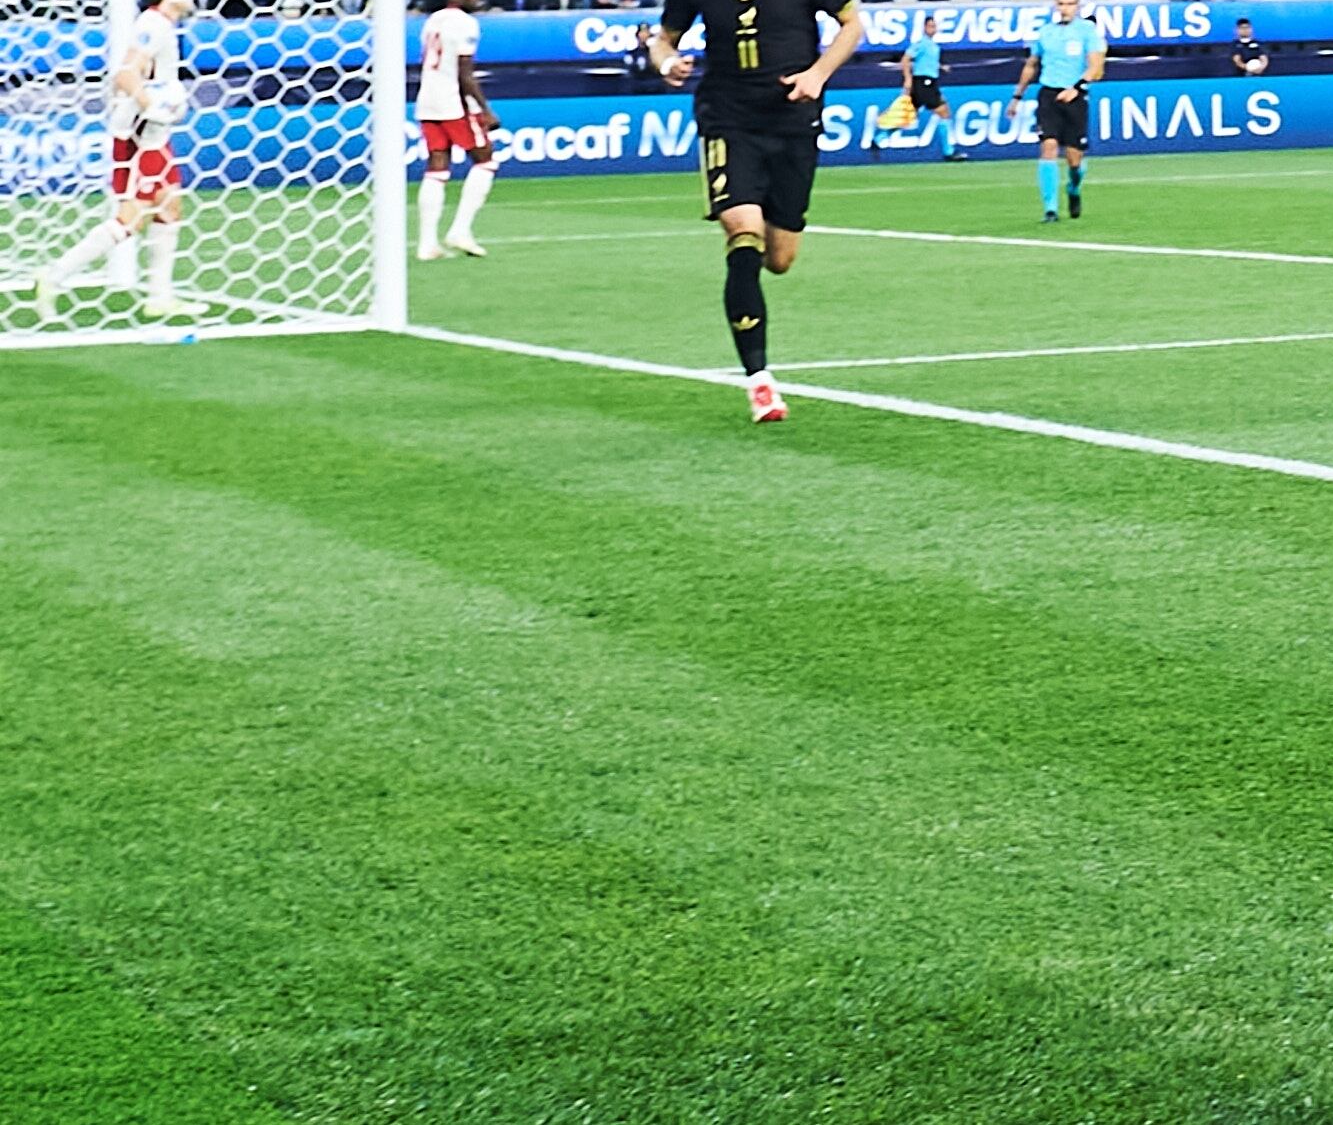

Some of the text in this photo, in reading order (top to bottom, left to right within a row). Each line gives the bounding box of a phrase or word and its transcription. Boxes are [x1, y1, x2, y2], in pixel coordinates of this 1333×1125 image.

[1096, 2, 1212, 39] NALS
[737, 38, 760, 70] 11
[1100, 91, 1281, 141] INALS
